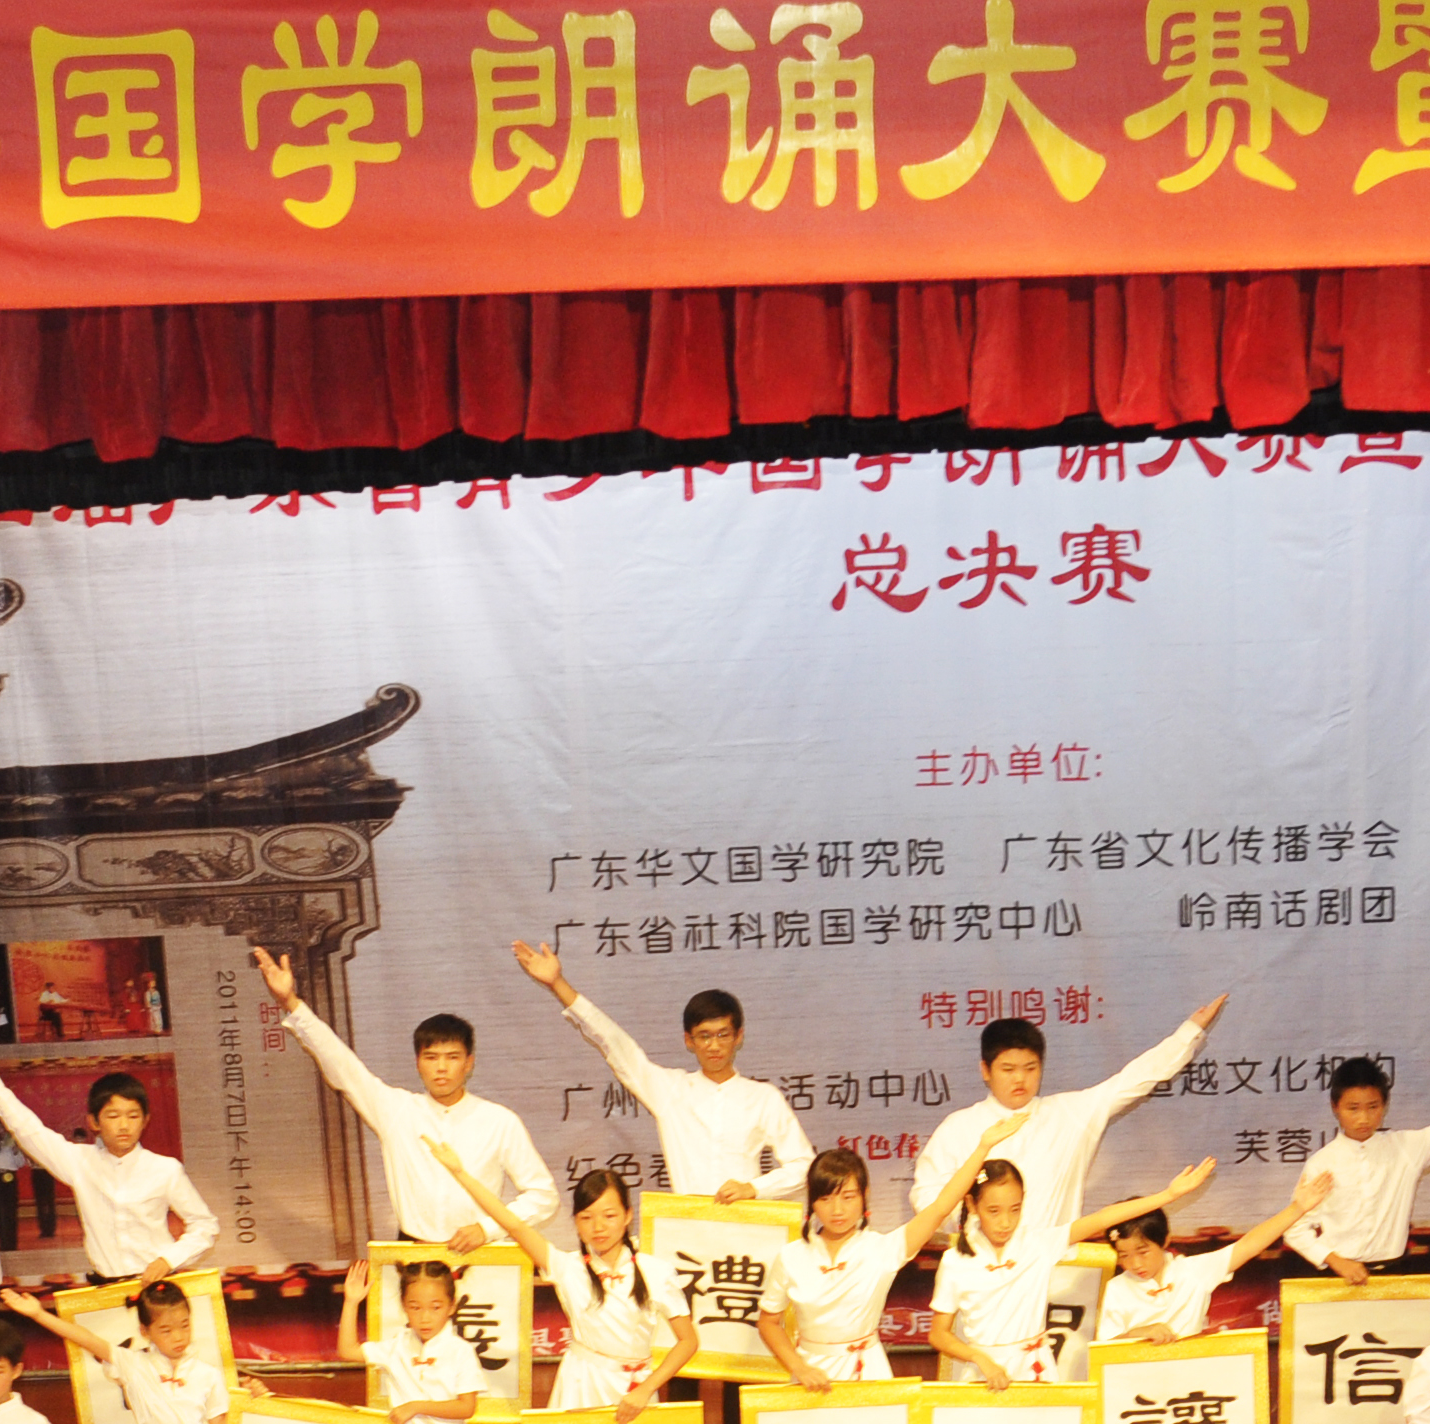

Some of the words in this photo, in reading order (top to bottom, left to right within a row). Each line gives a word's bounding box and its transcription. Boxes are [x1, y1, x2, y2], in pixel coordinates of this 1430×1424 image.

[831, 523, 1151, 613] 总决赛
[915, 742, 1102, 787] 主办单位:
[548, 838, 945, 893] 广东华文国学研究院
[1000, 819, 1401, 874] 广东省文化传播学会
[553, 898, 1082, 957] 广东省社科院国学研究中心
[1179, 886, 1397, 931] 岭南话剧团
[1304, 1332, 1427, 1405] 信
